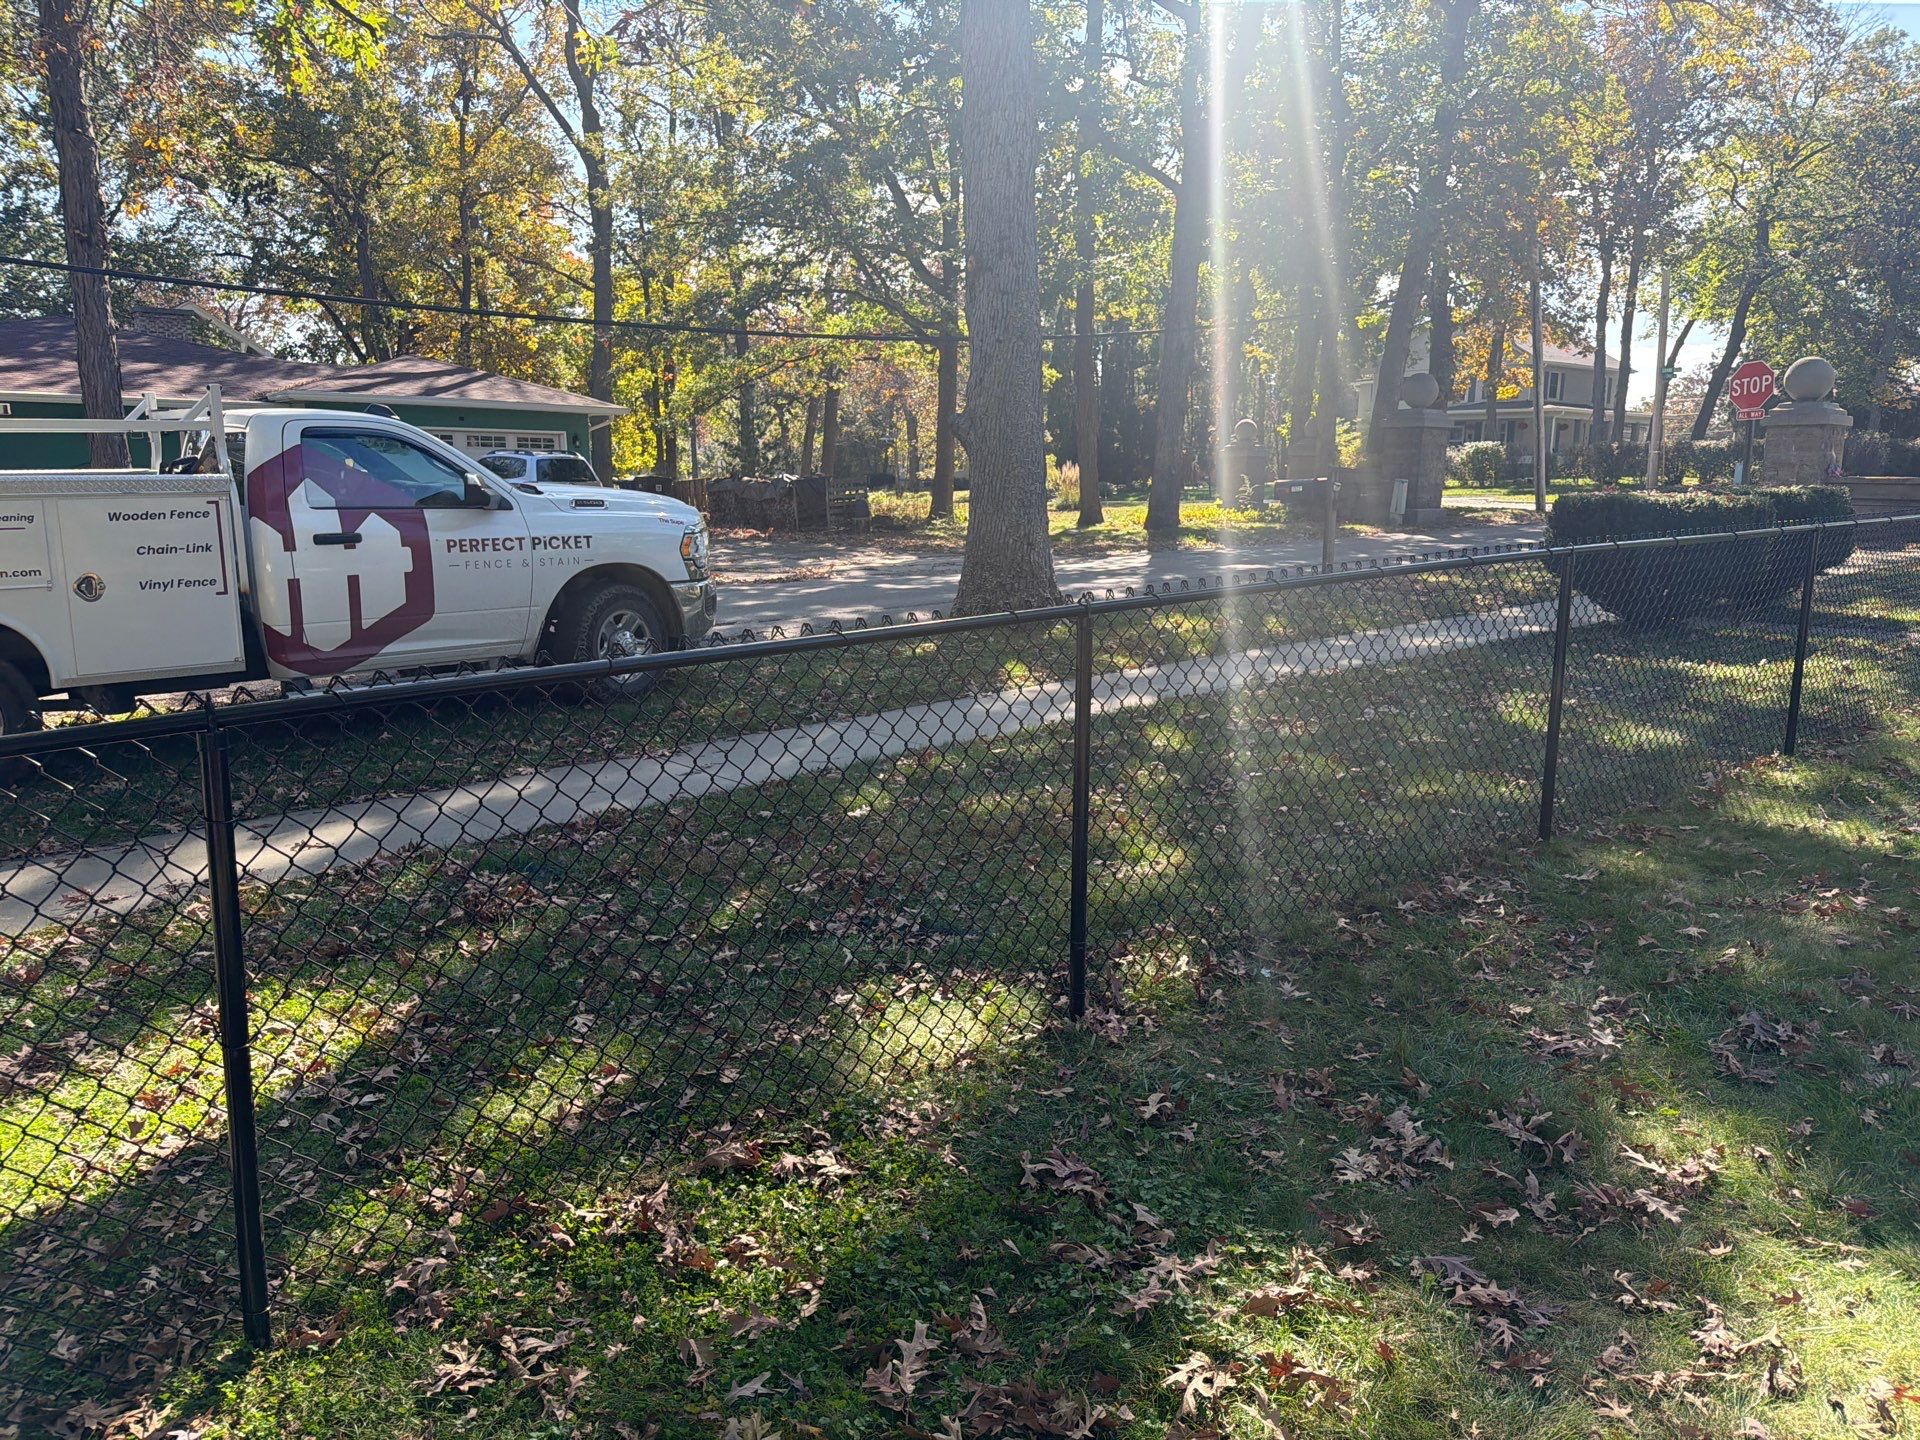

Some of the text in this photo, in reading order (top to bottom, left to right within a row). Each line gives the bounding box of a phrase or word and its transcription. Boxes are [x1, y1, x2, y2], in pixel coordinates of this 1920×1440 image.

[1731, 375, 1772, 397] STOP
[107, 509, 211, 521] Wooden Fence
[136, 543, 213, 555] Chain-Link
[445, 537, 526, 553] PERFECT
[465, 556, 581, 570] FENCE & STAIN
[139, 578, 217, 592] Vinyl Fence
